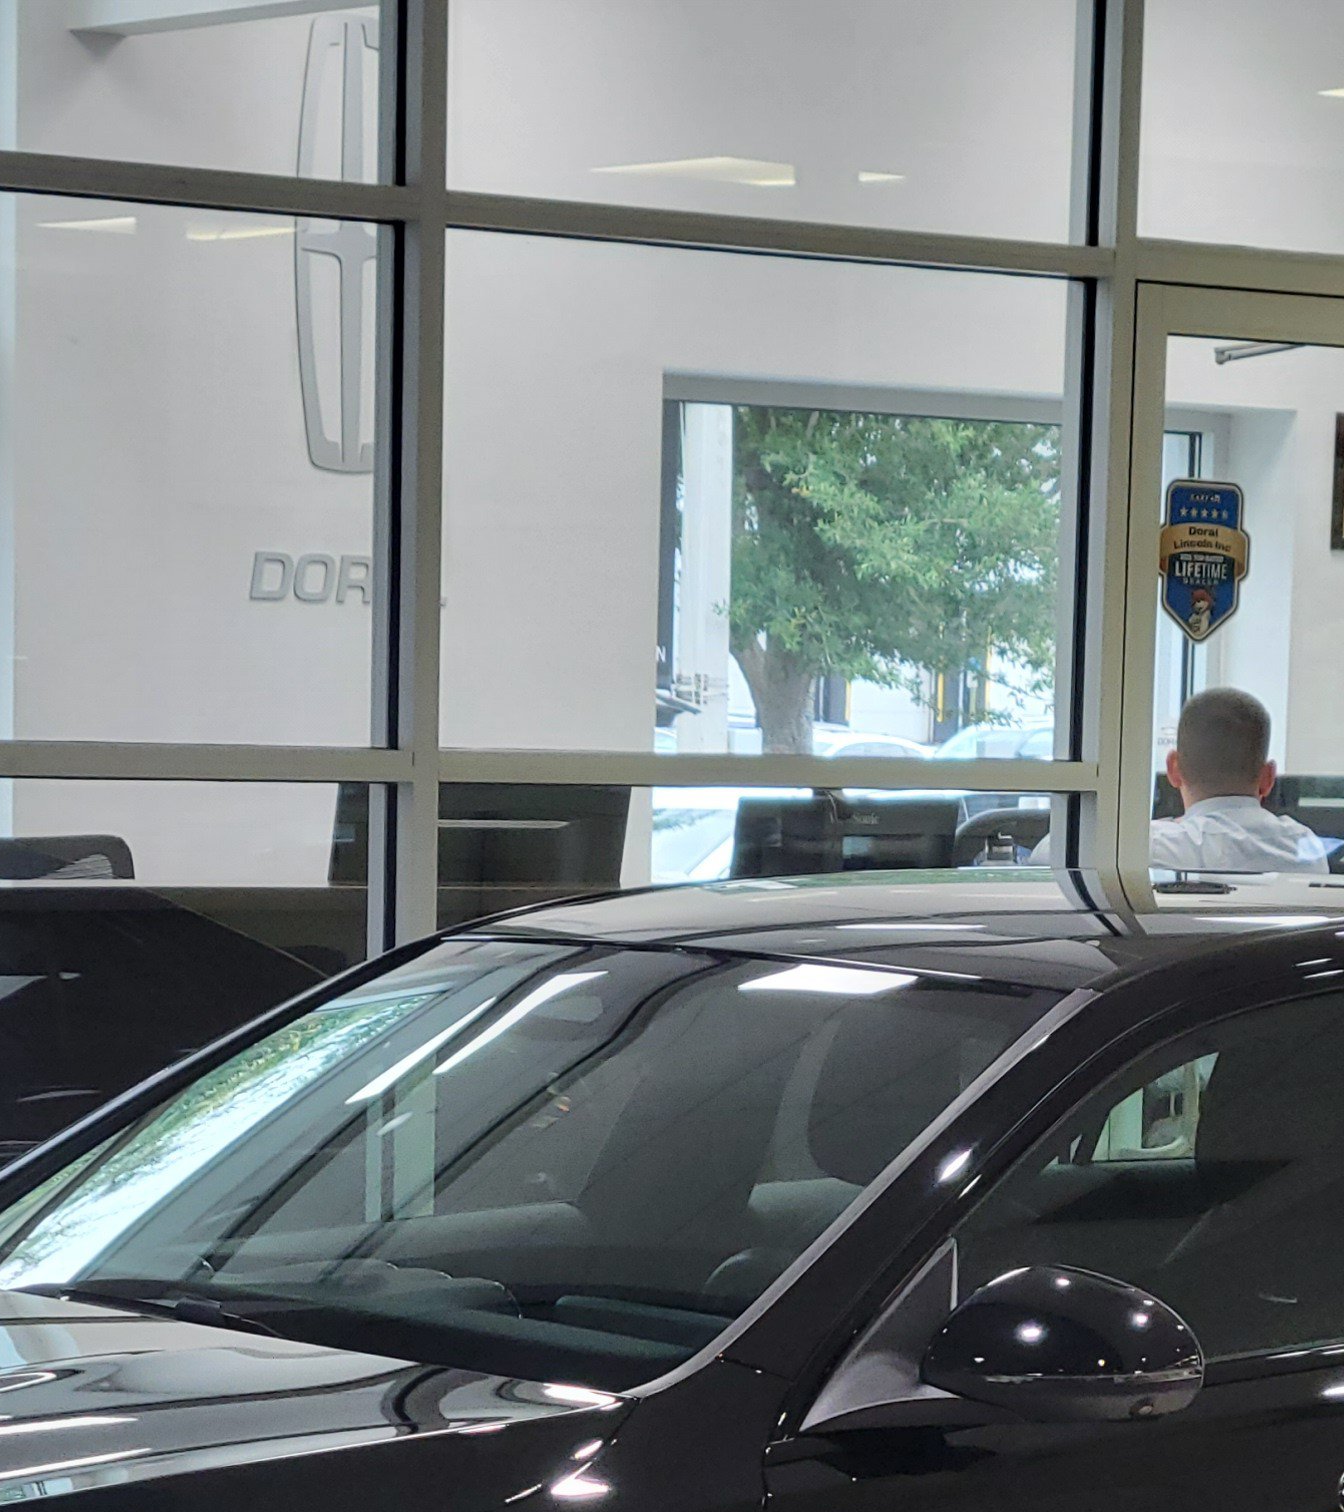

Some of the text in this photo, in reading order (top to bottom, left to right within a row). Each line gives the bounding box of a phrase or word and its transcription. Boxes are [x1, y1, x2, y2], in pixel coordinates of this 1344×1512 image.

[1188, 526, 1219, 537] Doral
[1173, 538, 1213, 551] Lincoln
[1175, 561, 1227, 580] LIFETIME
